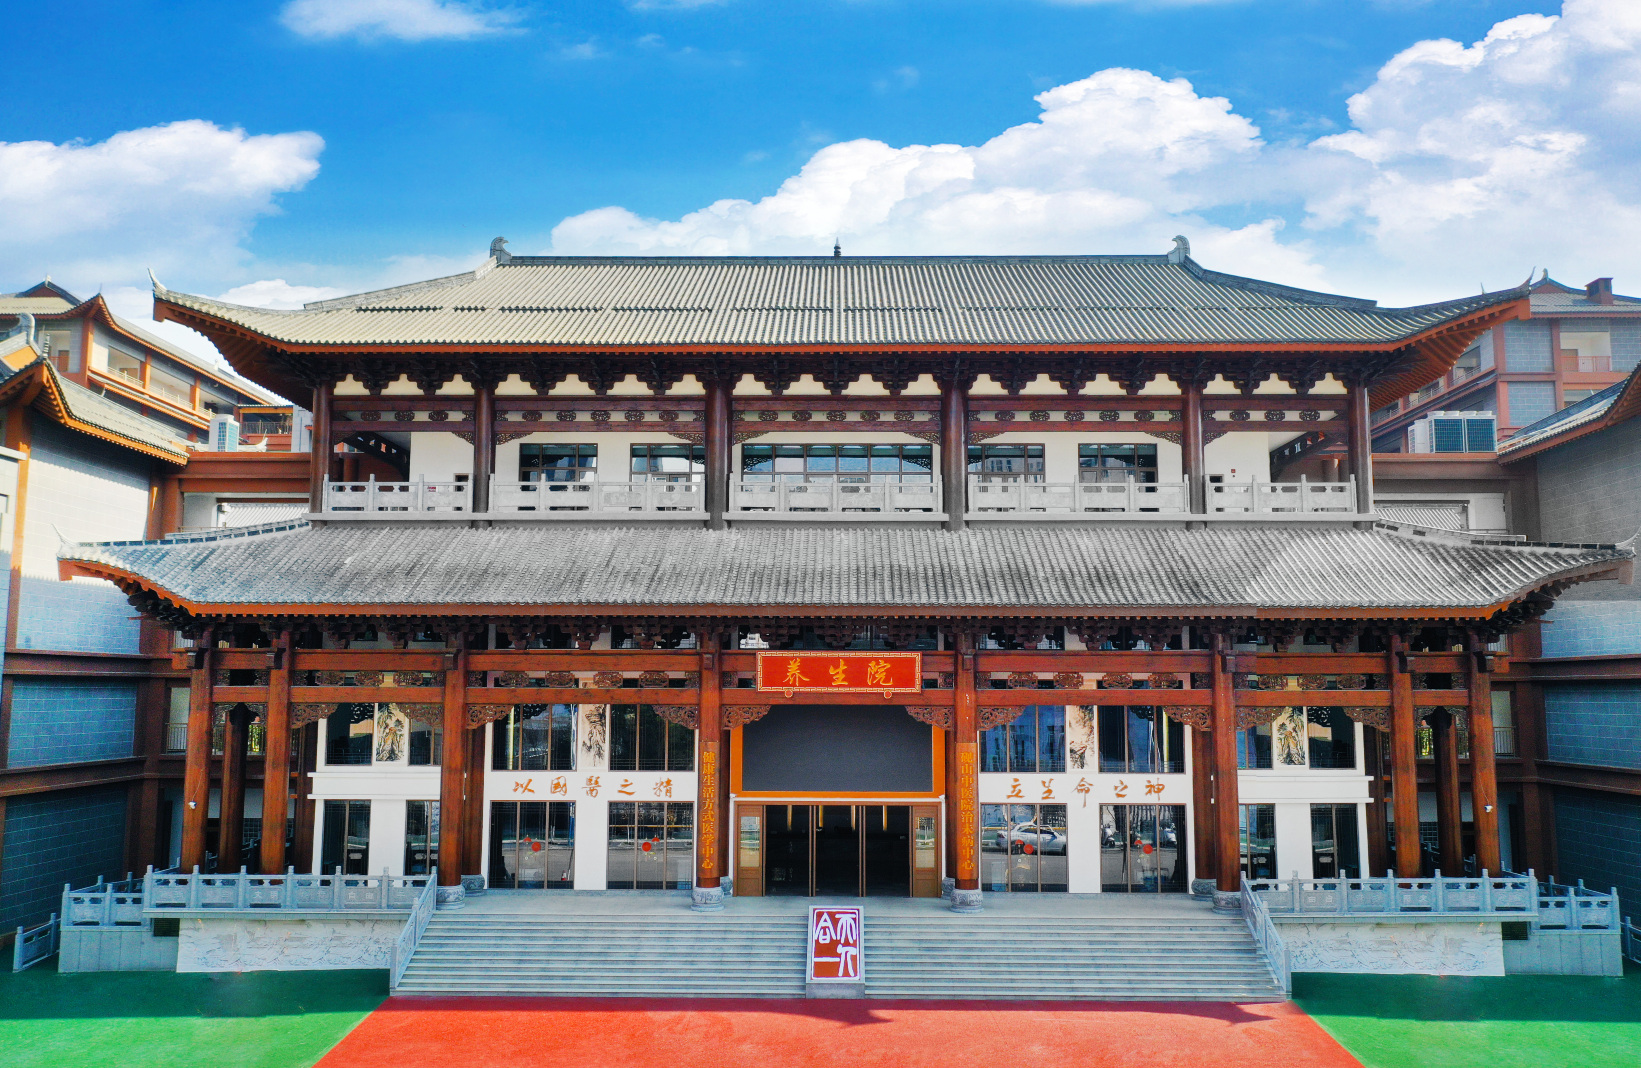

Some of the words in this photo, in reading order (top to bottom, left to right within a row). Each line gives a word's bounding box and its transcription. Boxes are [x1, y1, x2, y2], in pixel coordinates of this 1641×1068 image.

[783, 658, 893, 686] 养生院
[513, 775, 673, 798] 以國醫之精
[1007, 777, 1165, 808] 立生命之神
[702, 751, 716, 869] 健康生活方式医学中心
[960, 752, 975, 870] 砚山中医院治未病中心
